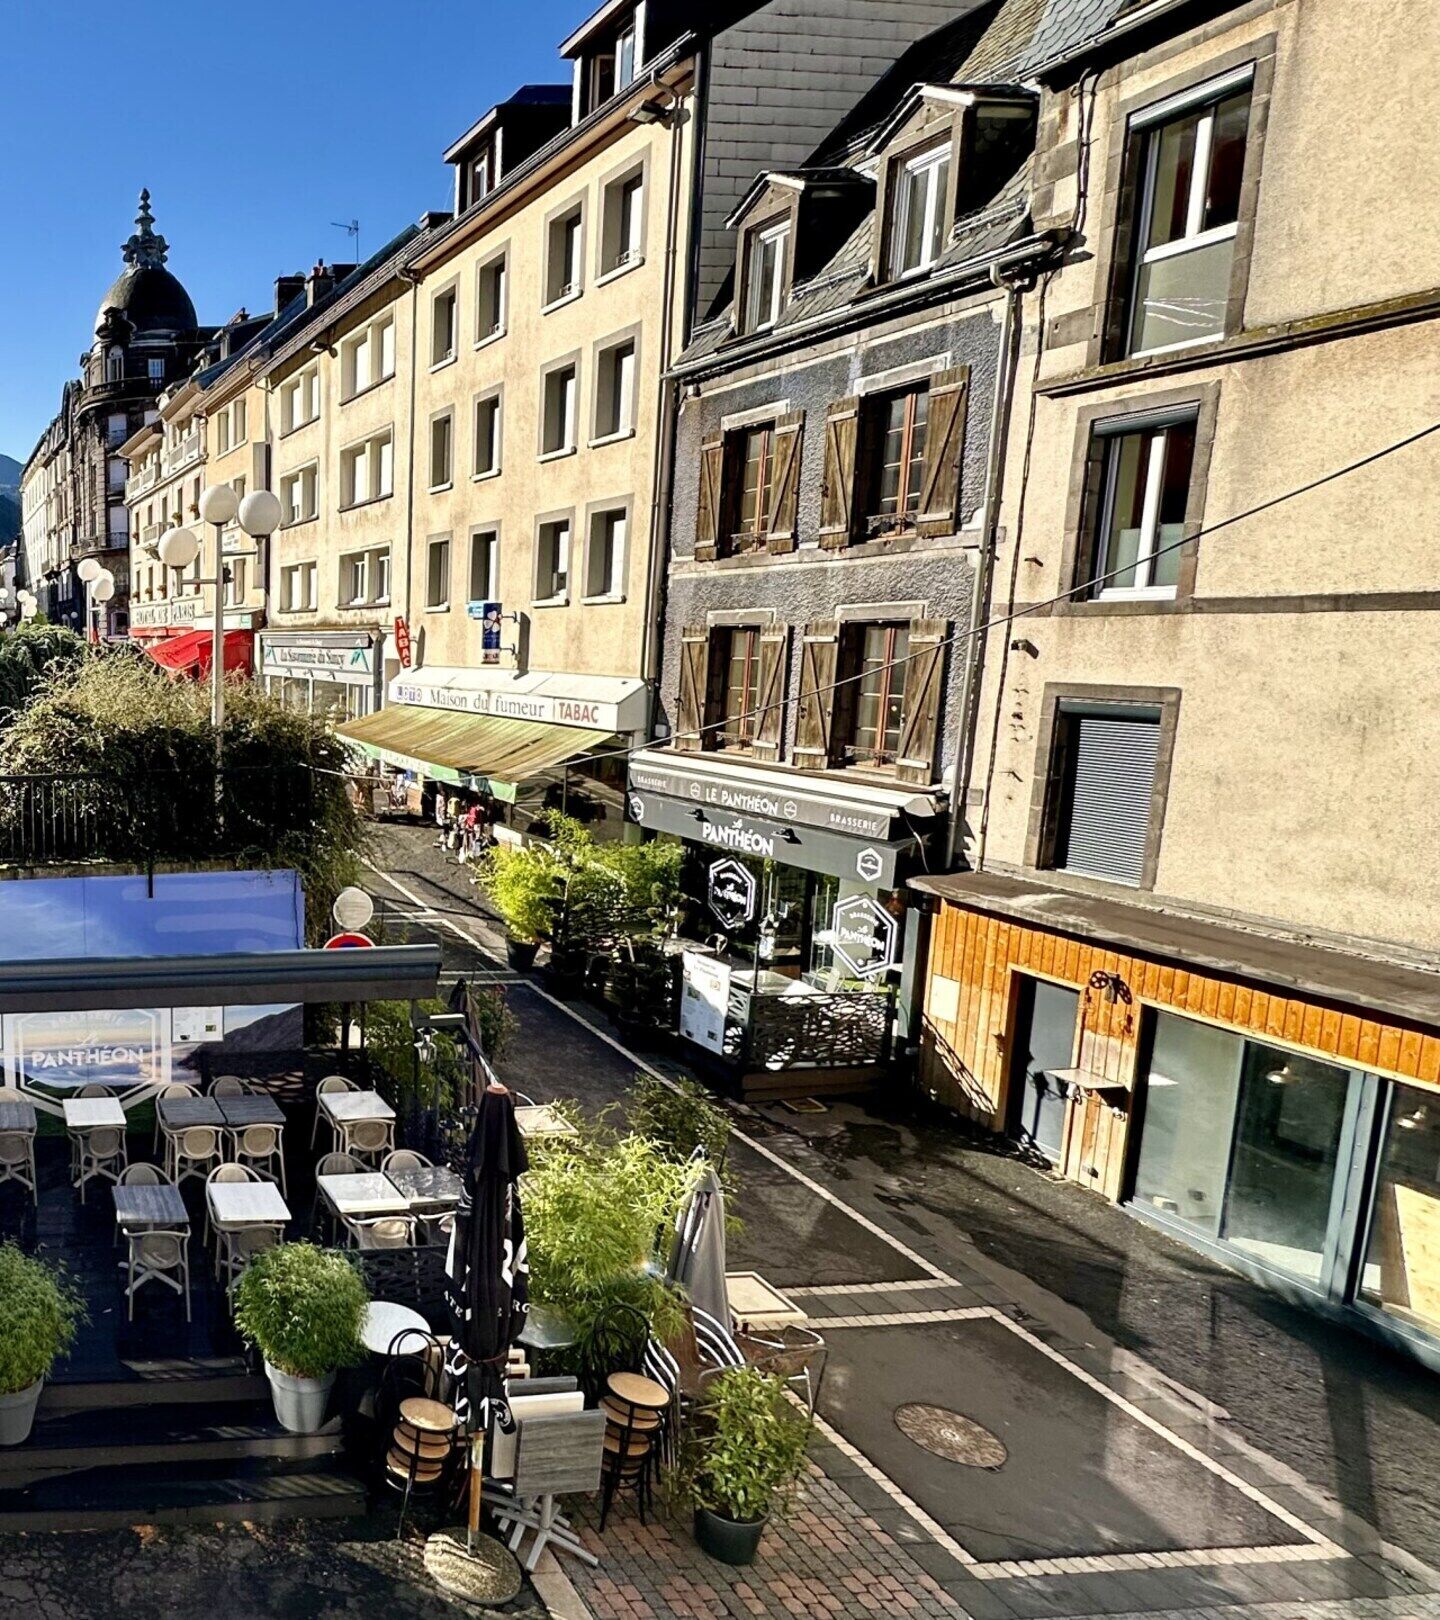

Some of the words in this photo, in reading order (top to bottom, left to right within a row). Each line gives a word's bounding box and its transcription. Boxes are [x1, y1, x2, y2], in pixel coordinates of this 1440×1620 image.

[396, 619, 410, 667] TABAC
[396, 685, 423, 702] LOTO
[429, 688, 468, 710] Maison
[473, 692, 489, 711] du
[495, 695, 545, 718] fumeur
[559, 701, 600, 724] TABAC
[705, 787, 718, 802] LE
[721, 790, 779, 817] PANTHÉON
[829, 813, 878, 831] BRASSERIE
[702, 822, 774, 857] PANTHÉON
[31, 1046, 143, 1068] PANTHÉON
